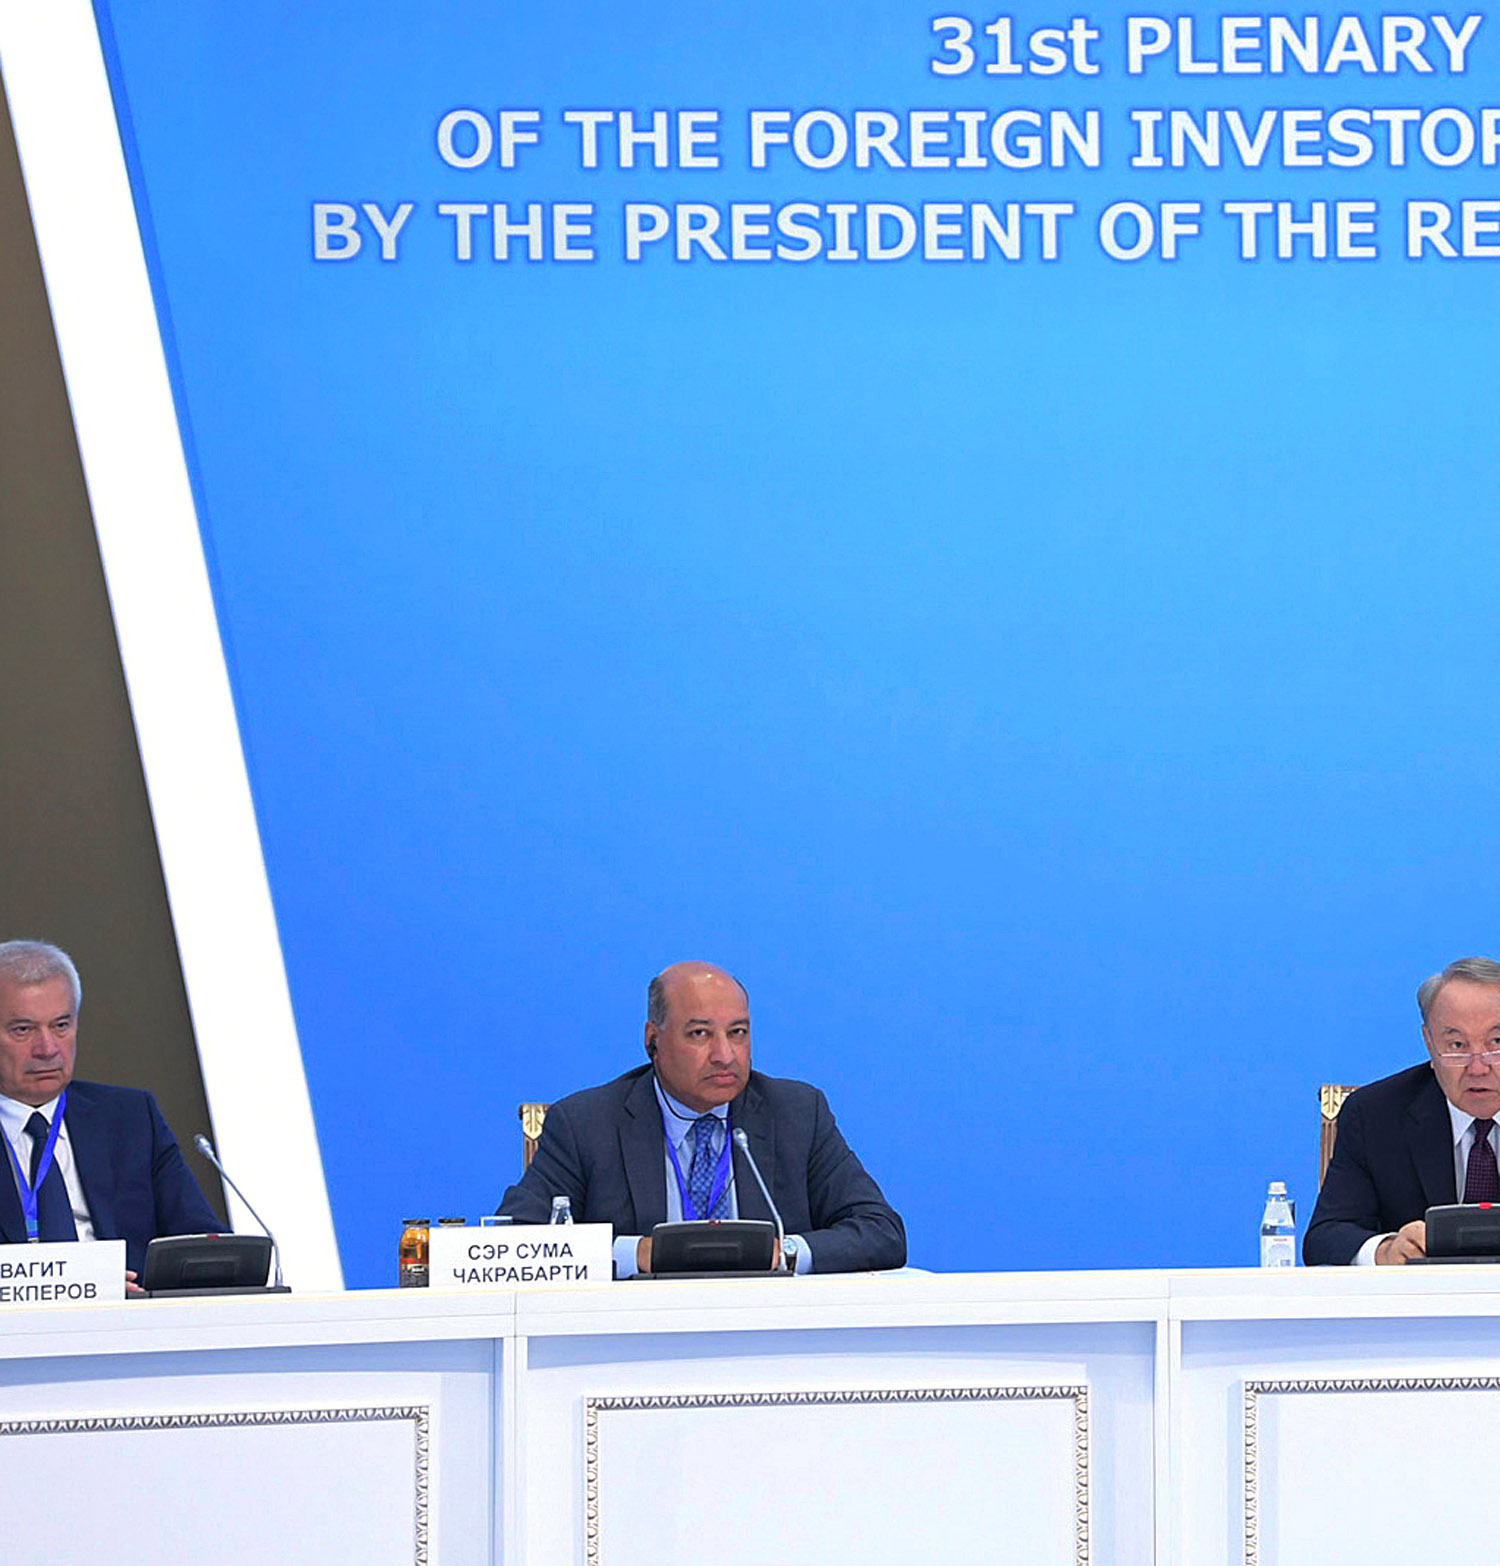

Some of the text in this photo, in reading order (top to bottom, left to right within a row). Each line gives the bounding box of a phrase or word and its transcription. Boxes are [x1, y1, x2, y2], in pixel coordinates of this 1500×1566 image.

[932, 16, 1099, 75] 31st
[1127, 15, 1482, 74] PLENARY
[437, 110, 540, 168] OF
[564, 111, 719, 168] THE
[750, 110, 1100, 168] FOREIGN
[314, 203, 413, 260] BY
[438, 204, 594, 260] THE
[625, 203, 1074, 261] PRESIDENT
[1099, 202, 1201, 260] OF
[1224, 201, 1376, 259] THE
[467, 1242, 574, 1261] СЭР СУМА
[0, 1260, 68, 1279] ВАГИТ
[453, 1264, 588, 1284] ЧАКРАБАРТИ
[0, 1282, 97, 1302] ЕКПЕРОВ
